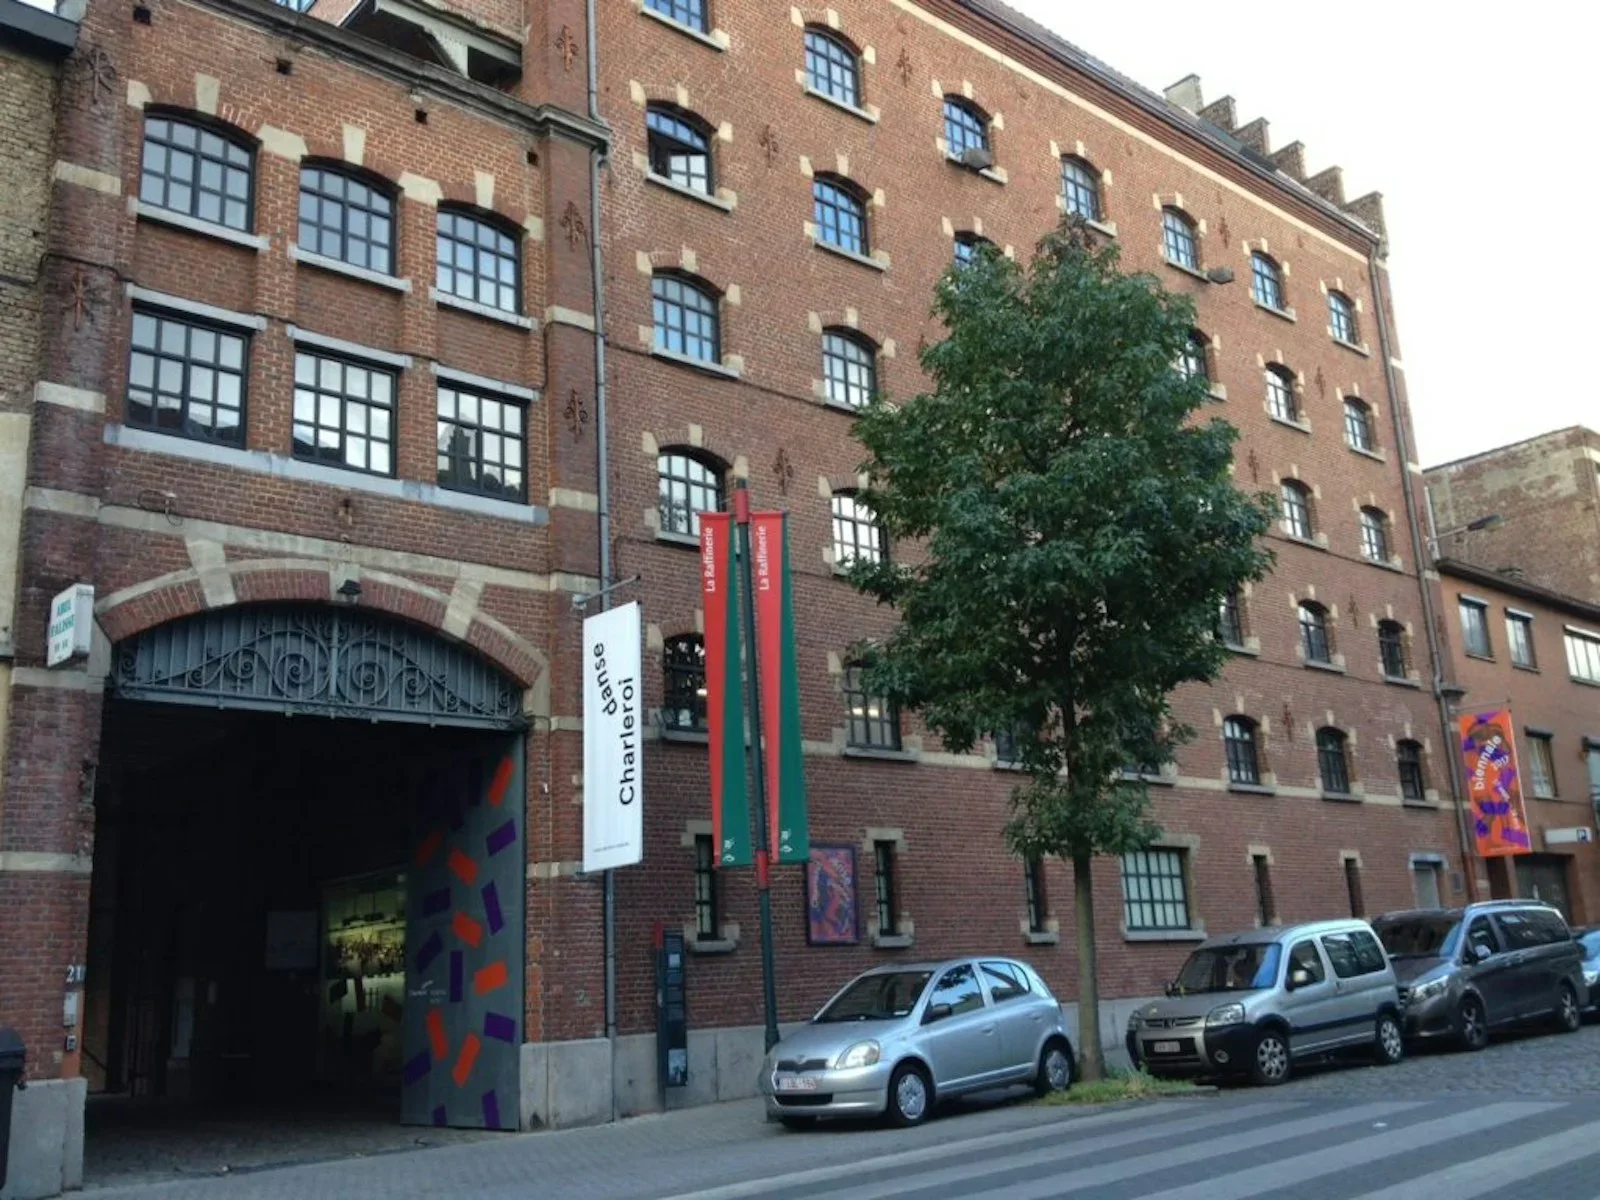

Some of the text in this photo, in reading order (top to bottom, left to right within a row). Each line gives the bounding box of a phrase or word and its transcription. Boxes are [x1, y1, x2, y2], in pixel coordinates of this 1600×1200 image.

[705, 580, 716, 592] La
[759, 578, 770, 590] La
[593, 642, 618, 716] danse
[618, 677, 635, 806] Charleroi
[1473, 735, 1502, 791] biennale
